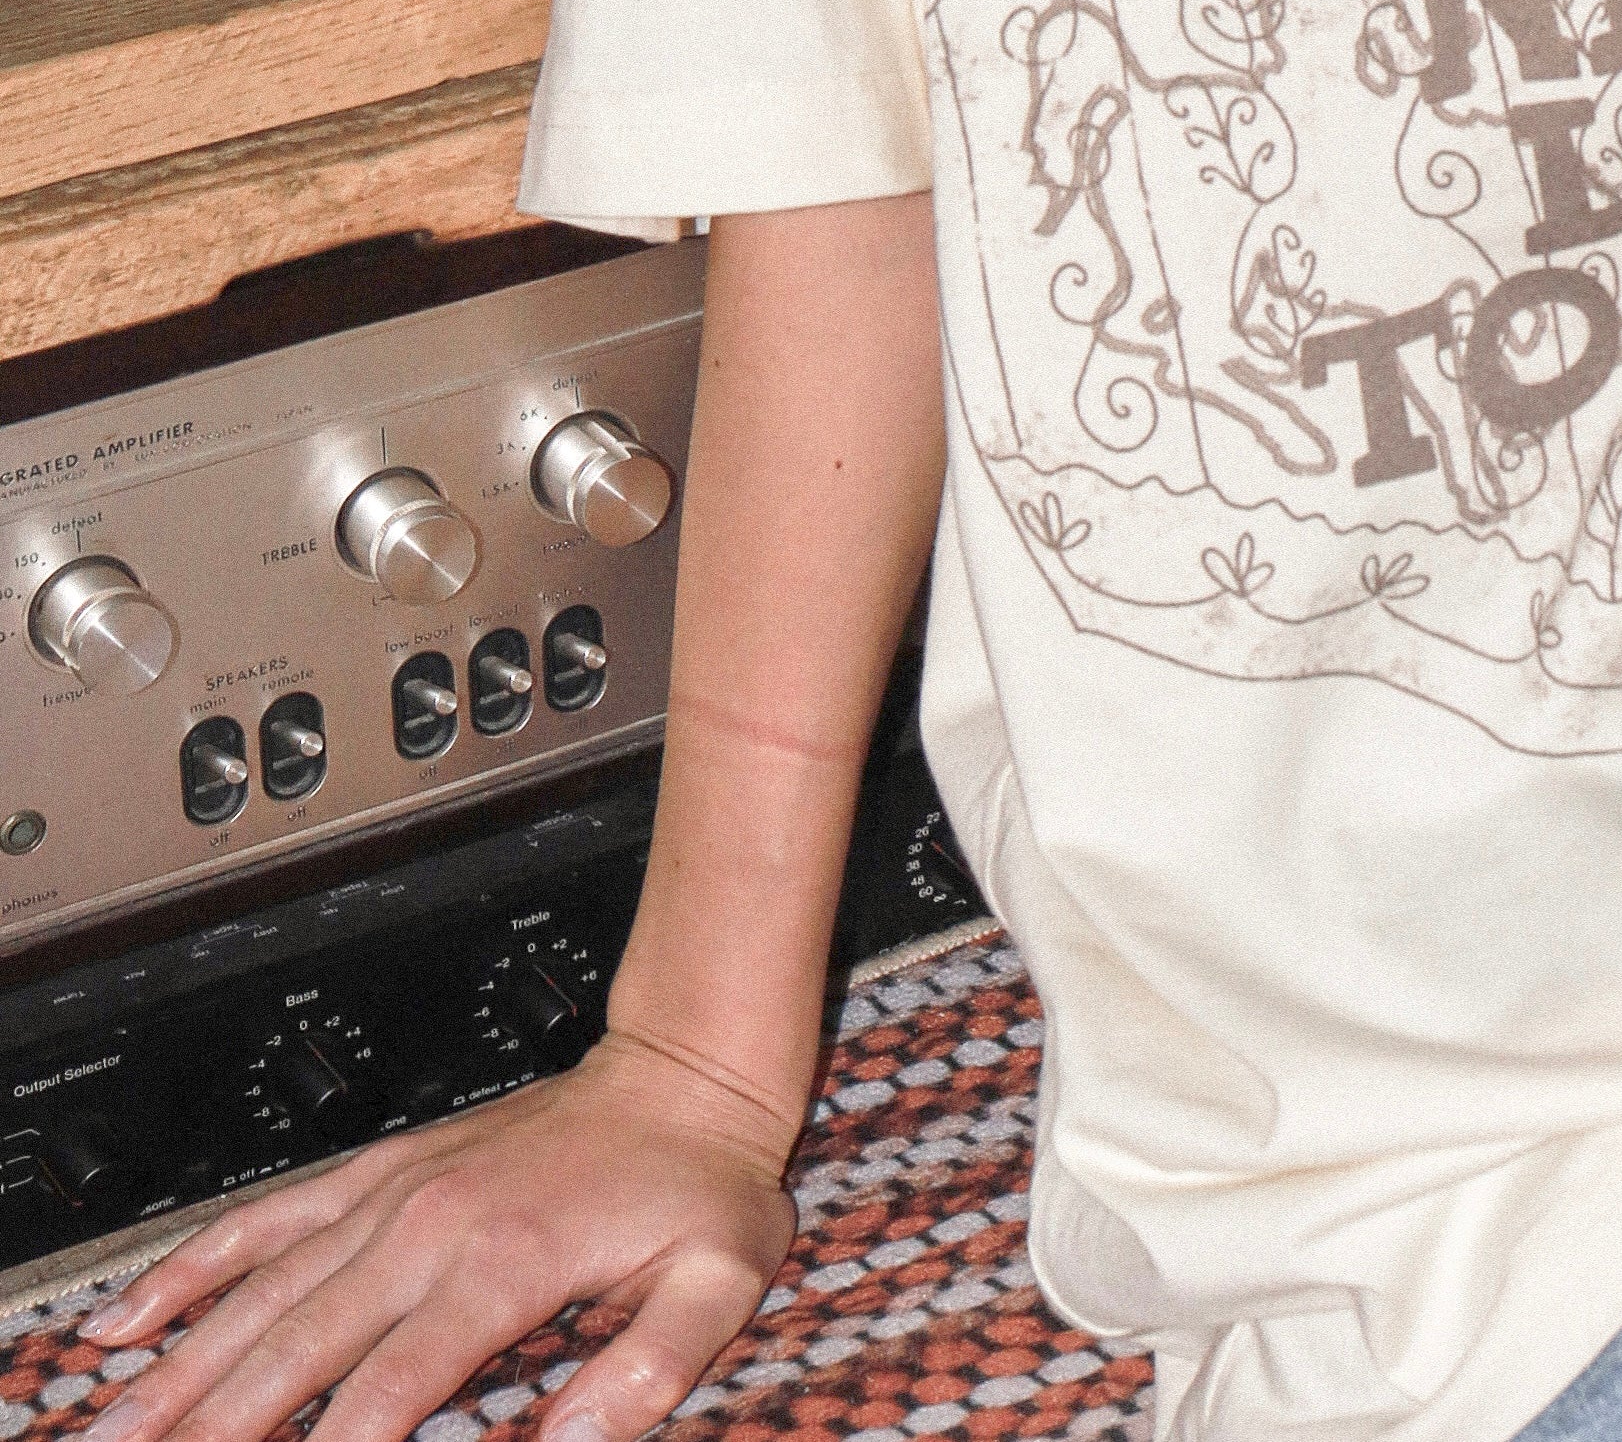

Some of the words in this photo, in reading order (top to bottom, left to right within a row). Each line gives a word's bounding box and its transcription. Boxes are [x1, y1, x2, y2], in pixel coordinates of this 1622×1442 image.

[0, 454, 79, 487] GRATED
[93, 421, 195, 461] AMPLIFIER
[261, 537, 318, 566] TREBLE
[204, 655, 289, 692] SPEAKERS
[190, 695, 227, 715] main
[914, 825, 930, 839] 26
[907, 842, 923, 855] 30
[911, 874, 926, 887] 48
[918, 885, 934, 899] 60
[510, 910, 551, 931] Treble
[285, 989, 320, 1008] Bass
[13, 1073, 61, 1098] Output
[64, 1054, 122, 1081] Selector
[468, 1082, 501, 1101] defeat
[520, 1071, 535, 1083] on
[239, 1168, 256, 1181] off
[275, 1157, 290, 1169] on
